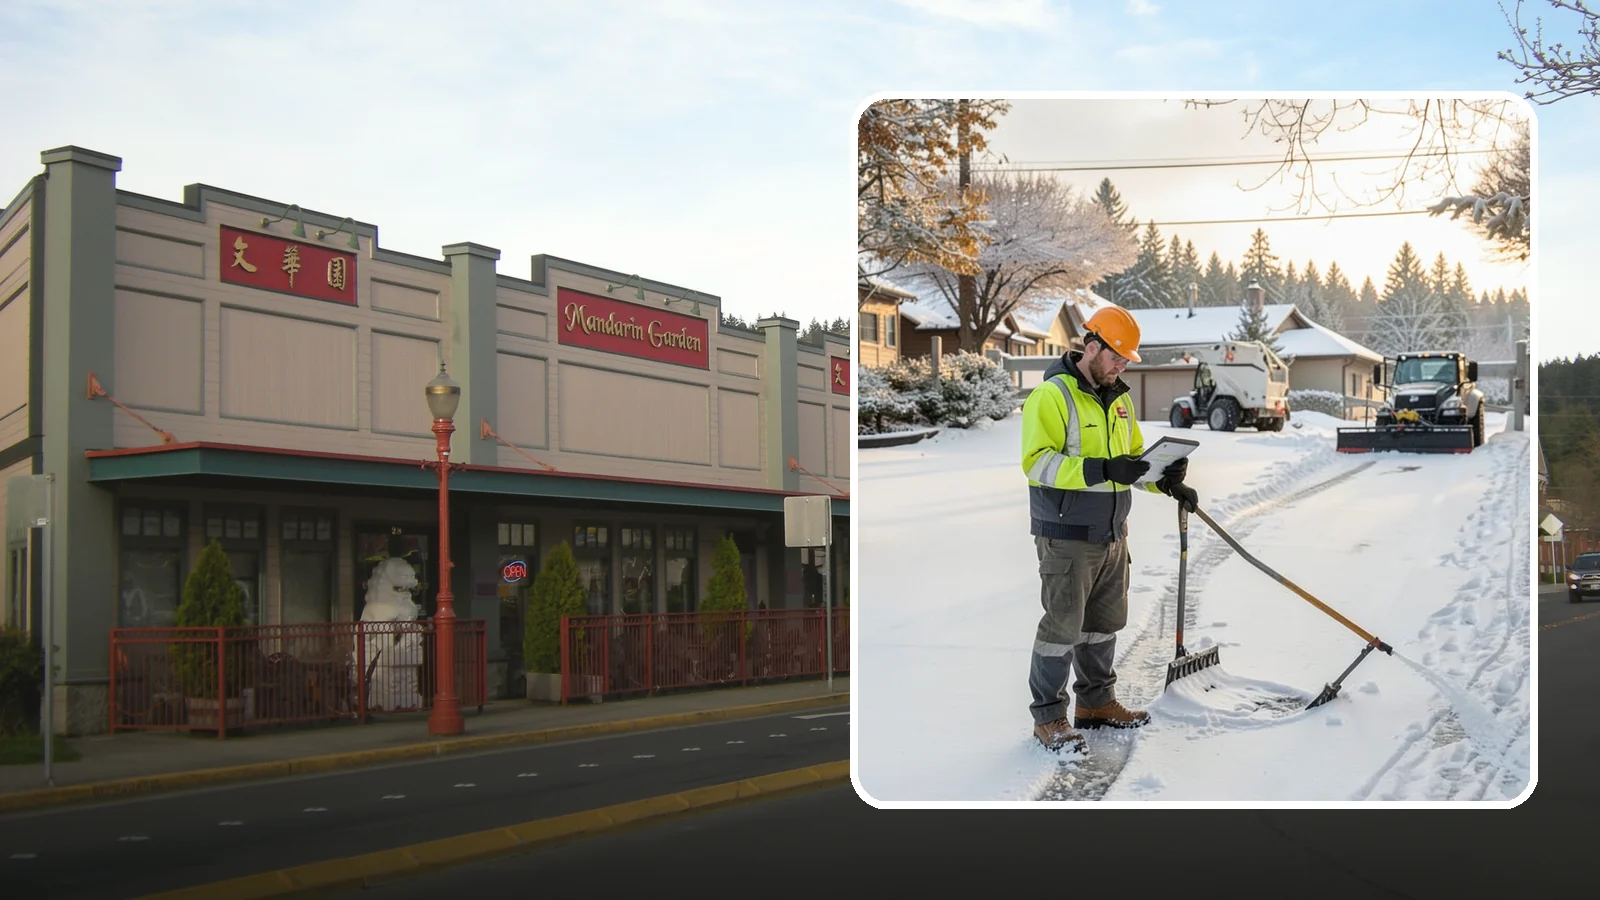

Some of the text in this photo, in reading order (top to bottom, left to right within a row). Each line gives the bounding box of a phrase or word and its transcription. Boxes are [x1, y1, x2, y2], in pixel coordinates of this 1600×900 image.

[564, 302, 701, 352] Mandarin Garden
[503, 565, 527, 578] OPEN
